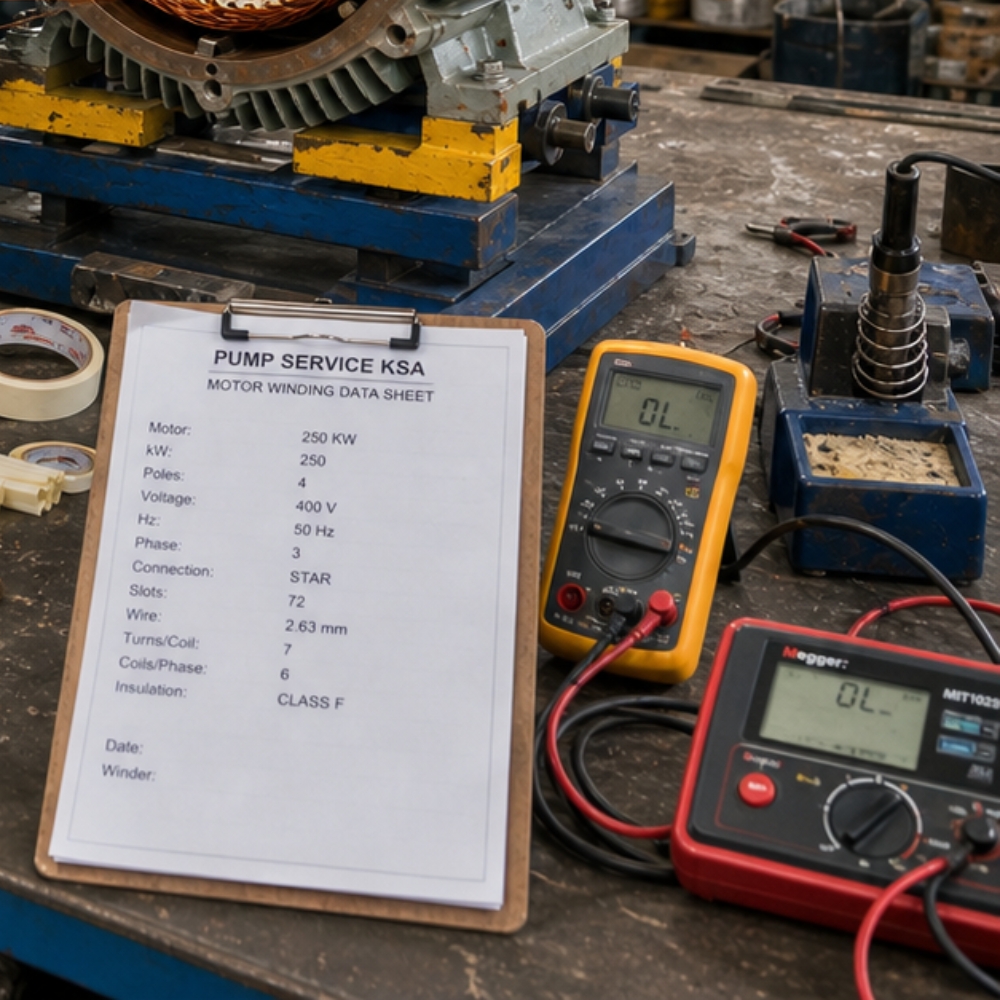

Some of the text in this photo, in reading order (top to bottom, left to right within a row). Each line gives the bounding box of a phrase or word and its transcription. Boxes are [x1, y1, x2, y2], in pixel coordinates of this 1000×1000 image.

[213, 349, 426, 377] PUMP SERVICE KSA
[206, 378, 435, 403] MOTOR WINDING DATA SHEET
[148, 421, 358, 446] Motor: 250 KW
[145, 444, 327, 468] kW: 250
[142, 466, 307, 489] Poles: 4
[141, 489, 338, 515] Voltage: 400 V
[137, 513, 335, 539] Hz: 50 Hz
[134, 535, 301, 560] Phase: 3
[131, 559, 332, 586] Connection: STAR
[128, 583, 306, 609] Slots: 72
[126, 608, 348, 636] Wire: 2.63 mm
[123, 631, 293, 656] Turns/Coil: 7
[118, 655, 290, 681] Coils/Phase: 6
[115, 680, 345, 710] Insulation: CLASS F
[105, 738, 143, 755] Date:
[101, 763, 156, 782] Winder:
